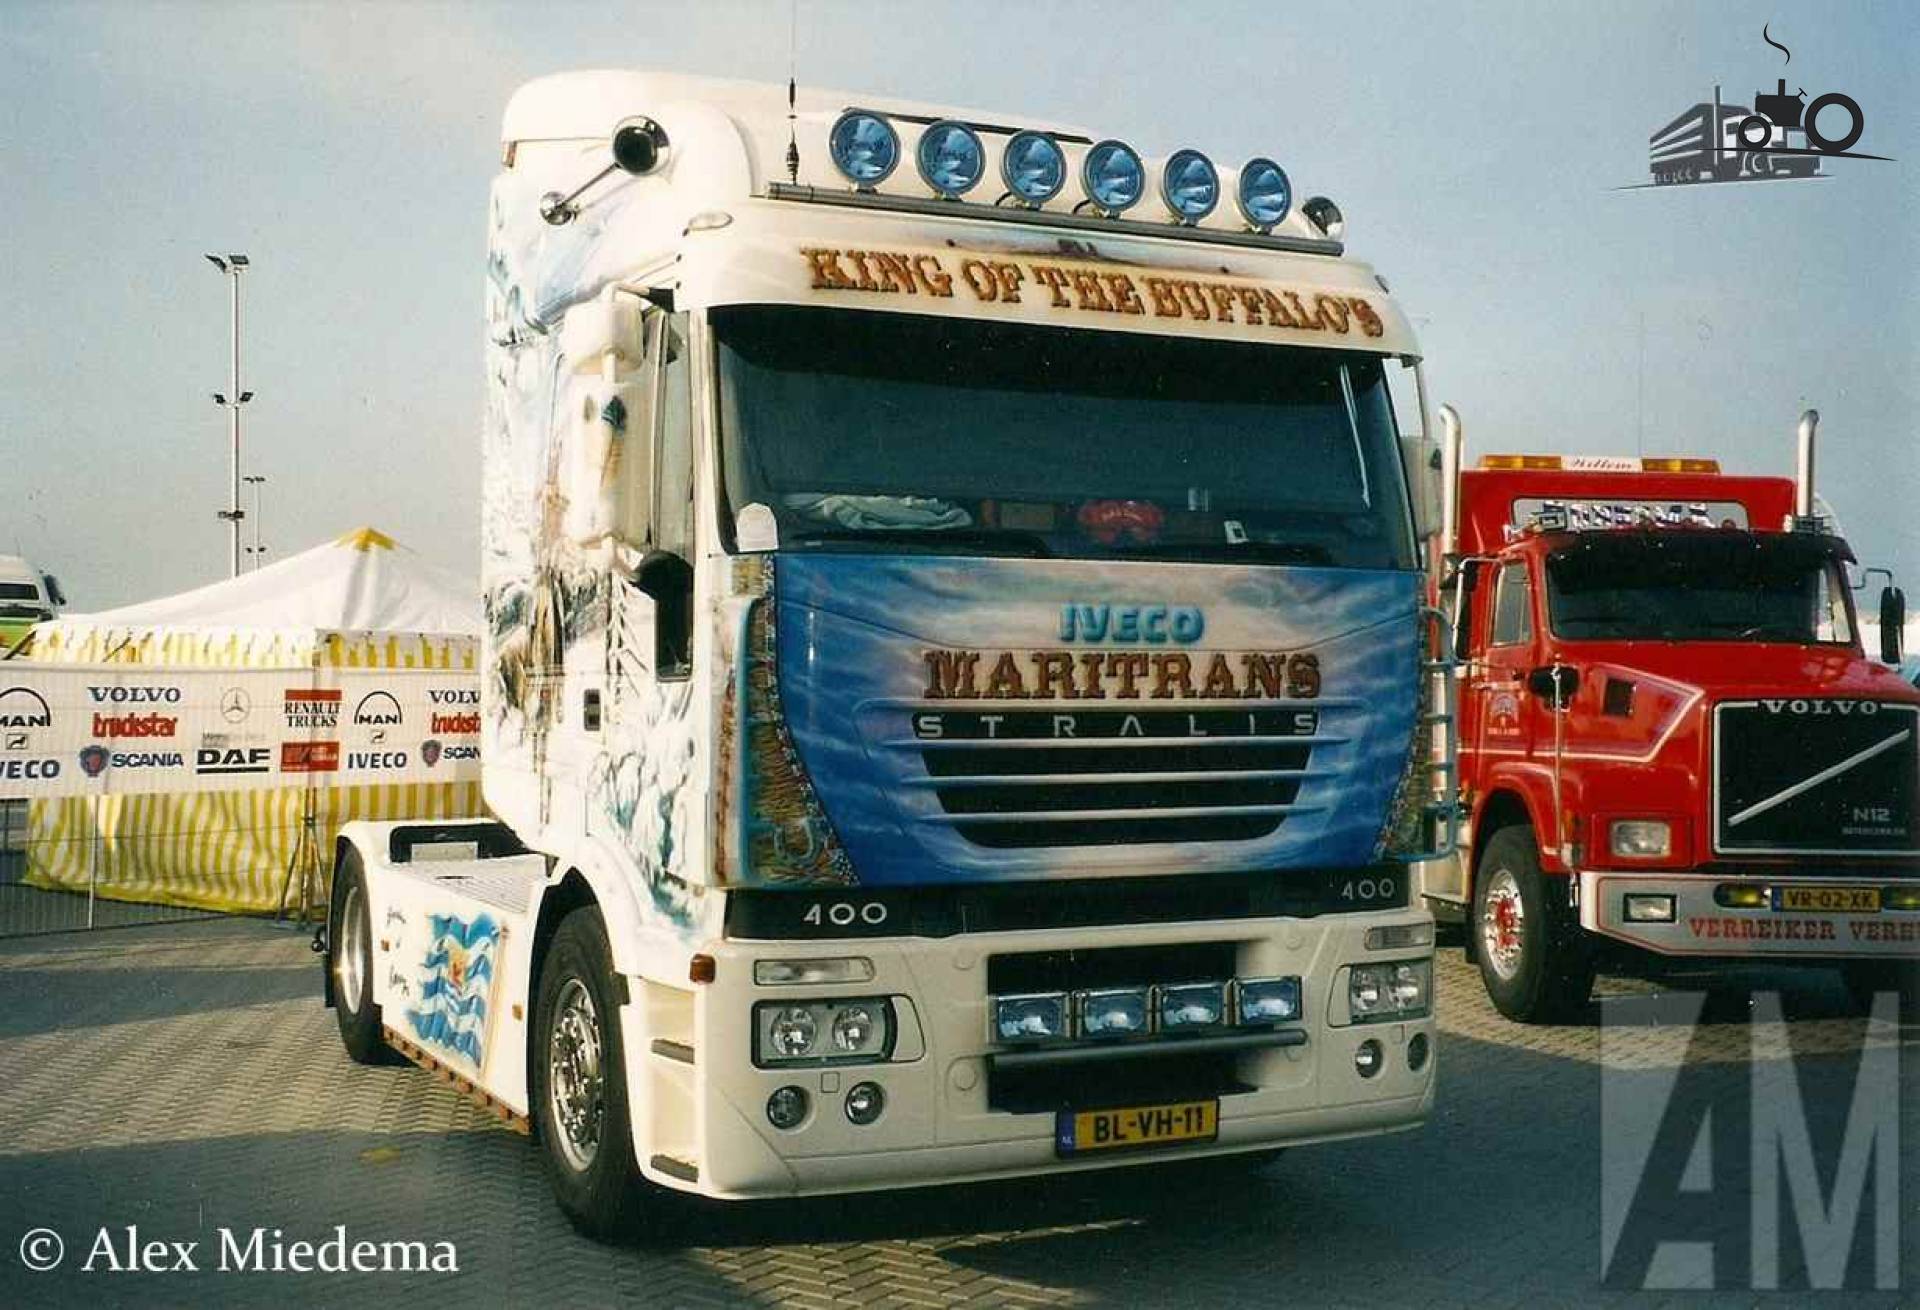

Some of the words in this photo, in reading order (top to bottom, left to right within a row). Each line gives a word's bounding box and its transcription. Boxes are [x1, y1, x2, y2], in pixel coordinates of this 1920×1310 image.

[801, 248, 953, 298] KING
[961, 257, 1024, 304] OF
[1029, 264, 1143, 316] THE
[1144, 277, 1385, 337] BUFFALO'S
[1060, 601, 1205, 644] IVECO
[922, 650, 1321, 700] MARITRANS
[87, 686, 181, 702] VOLVO
[427, 689, 482, 704] VOLV
[284, 702, 340, 715] RENAULT
[1760, 699, 1879, 714] VOLVO
[92, 712, 178, 738] truckstar
[286, 715, 338, 728] TRUCKS
[358, 714, 398, 725] MAN
[431, 712, 482, 734] truckst
[918, 713, 1317, 738] STRALIS
[111, 753, 184, 768] SCANIA
[197, 748, 271, 766] DAF
[348, 752, 407, 769] IVECO
[443, 747, 481, 760] SCAN
[1853, 807, 1891, 822] N12
[1341, 878, 1396, 901] 400
[803, 902, 888, 926] 400
[1689, 917, 1837, 940] VERREIKER
[1094, 1105, 1205, 1143] BL-VH-11
